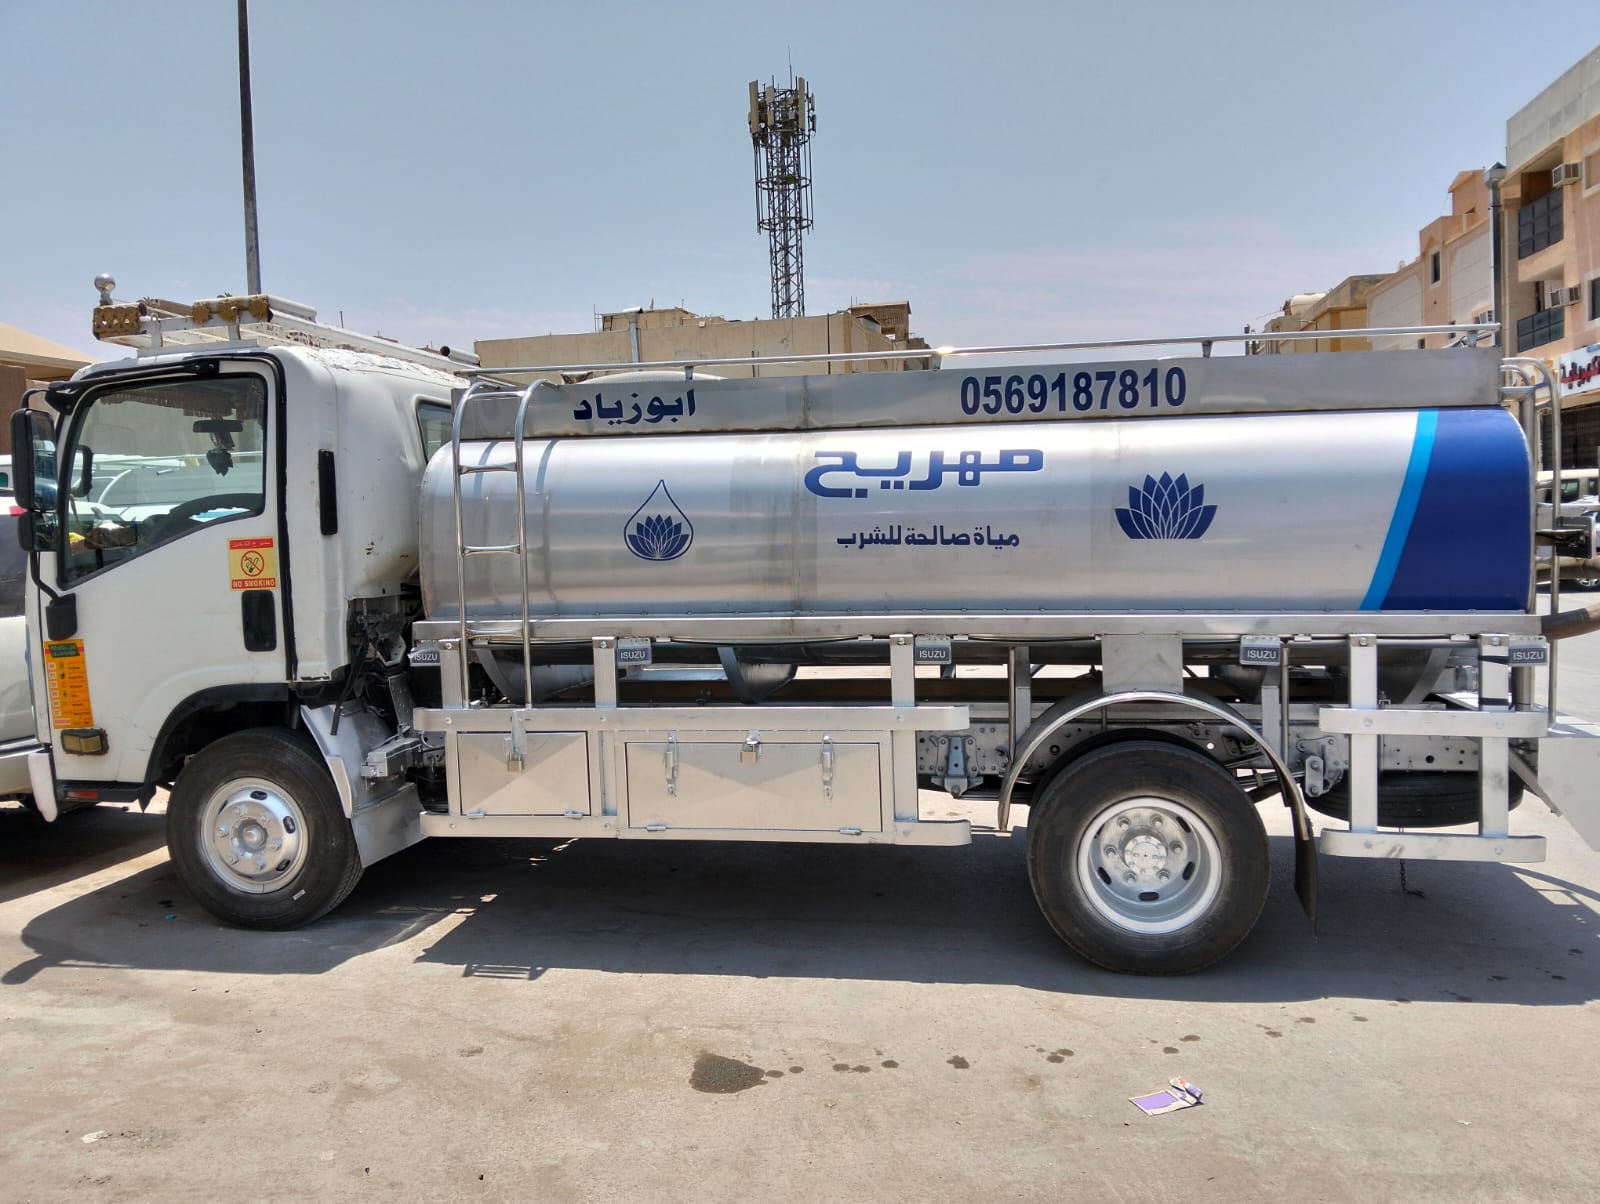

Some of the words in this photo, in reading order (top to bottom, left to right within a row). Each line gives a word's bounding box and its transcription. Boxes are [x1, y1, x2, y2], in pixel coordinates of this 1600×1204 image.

[960, 366, 1187, 415] 0569187810
[836, 525, 902, 550] للشرب
[904, 525, 970, 546] صالحة
[244, 579, 275, 588] SMOKING
[415, 653, 438, 661] ISUZU
[620, 650, 646, 659] ISUZU
[919, 650, 946, 659] ISUZU
[1246, 650, 1277, 659] ISUZU
[1512, 651, 1545, 660] ISUZU
